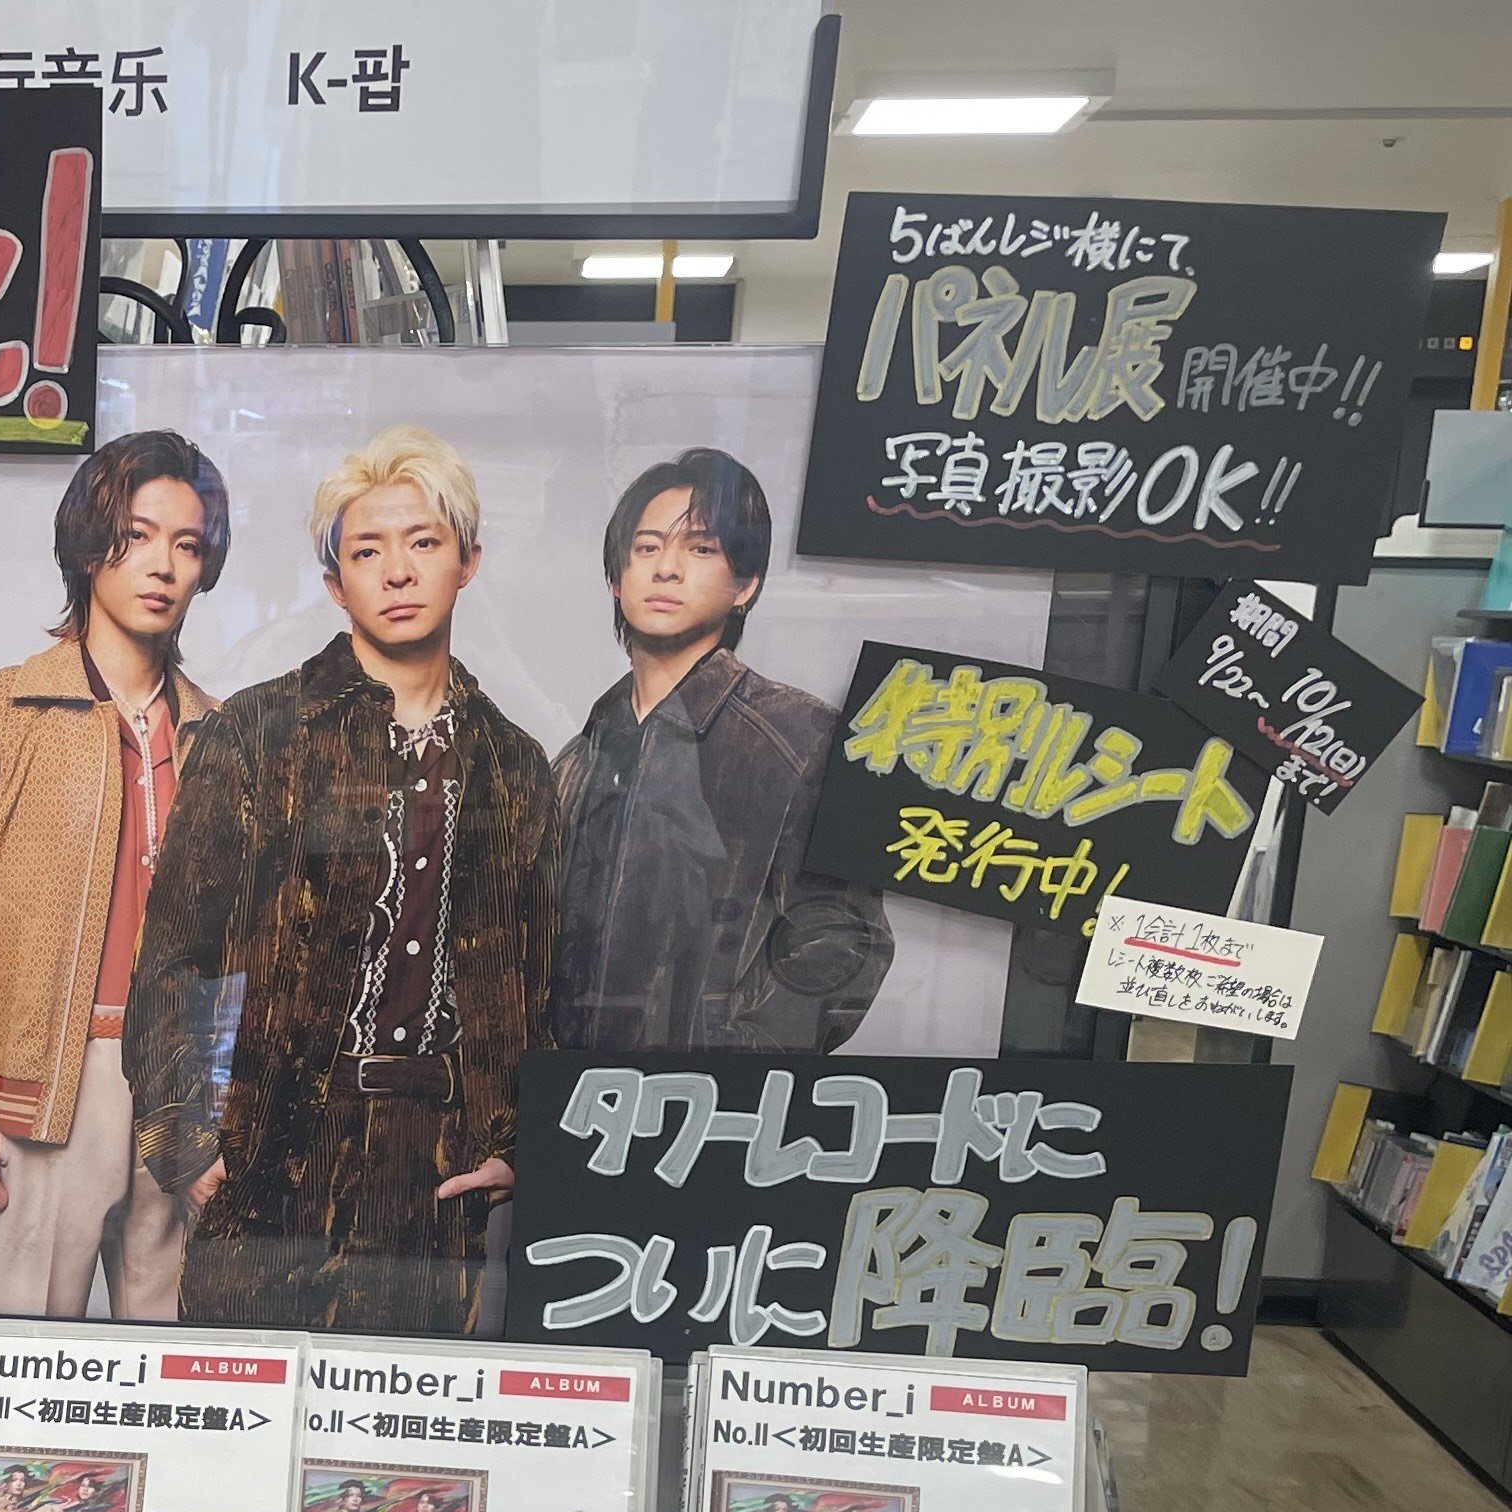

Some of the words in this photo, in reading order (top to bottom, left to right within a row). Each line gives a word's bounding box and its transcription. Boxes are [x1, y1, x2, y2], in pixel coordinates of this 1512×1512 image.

[288, 43, 411, 113] K-팝
[856, 265, 1197, 425] パネル展
[845, 658, 1255, 844] 特別レシート
[887, 806, 1131, 938] 発行中!
[559, 1067, 1106, 1187] タワーレコードに
[527, 1187, 1257, 1357] ついに降臨!
[191, 1360, 258, 1376] ALBUM
[309, 1359, 485, 1402] Number_i
[530, 1377, 601, 1394] ALBUM
[721, 1369, 915, 1417] Number_i
[962, 1393, 1036, 1411] ALBUM
